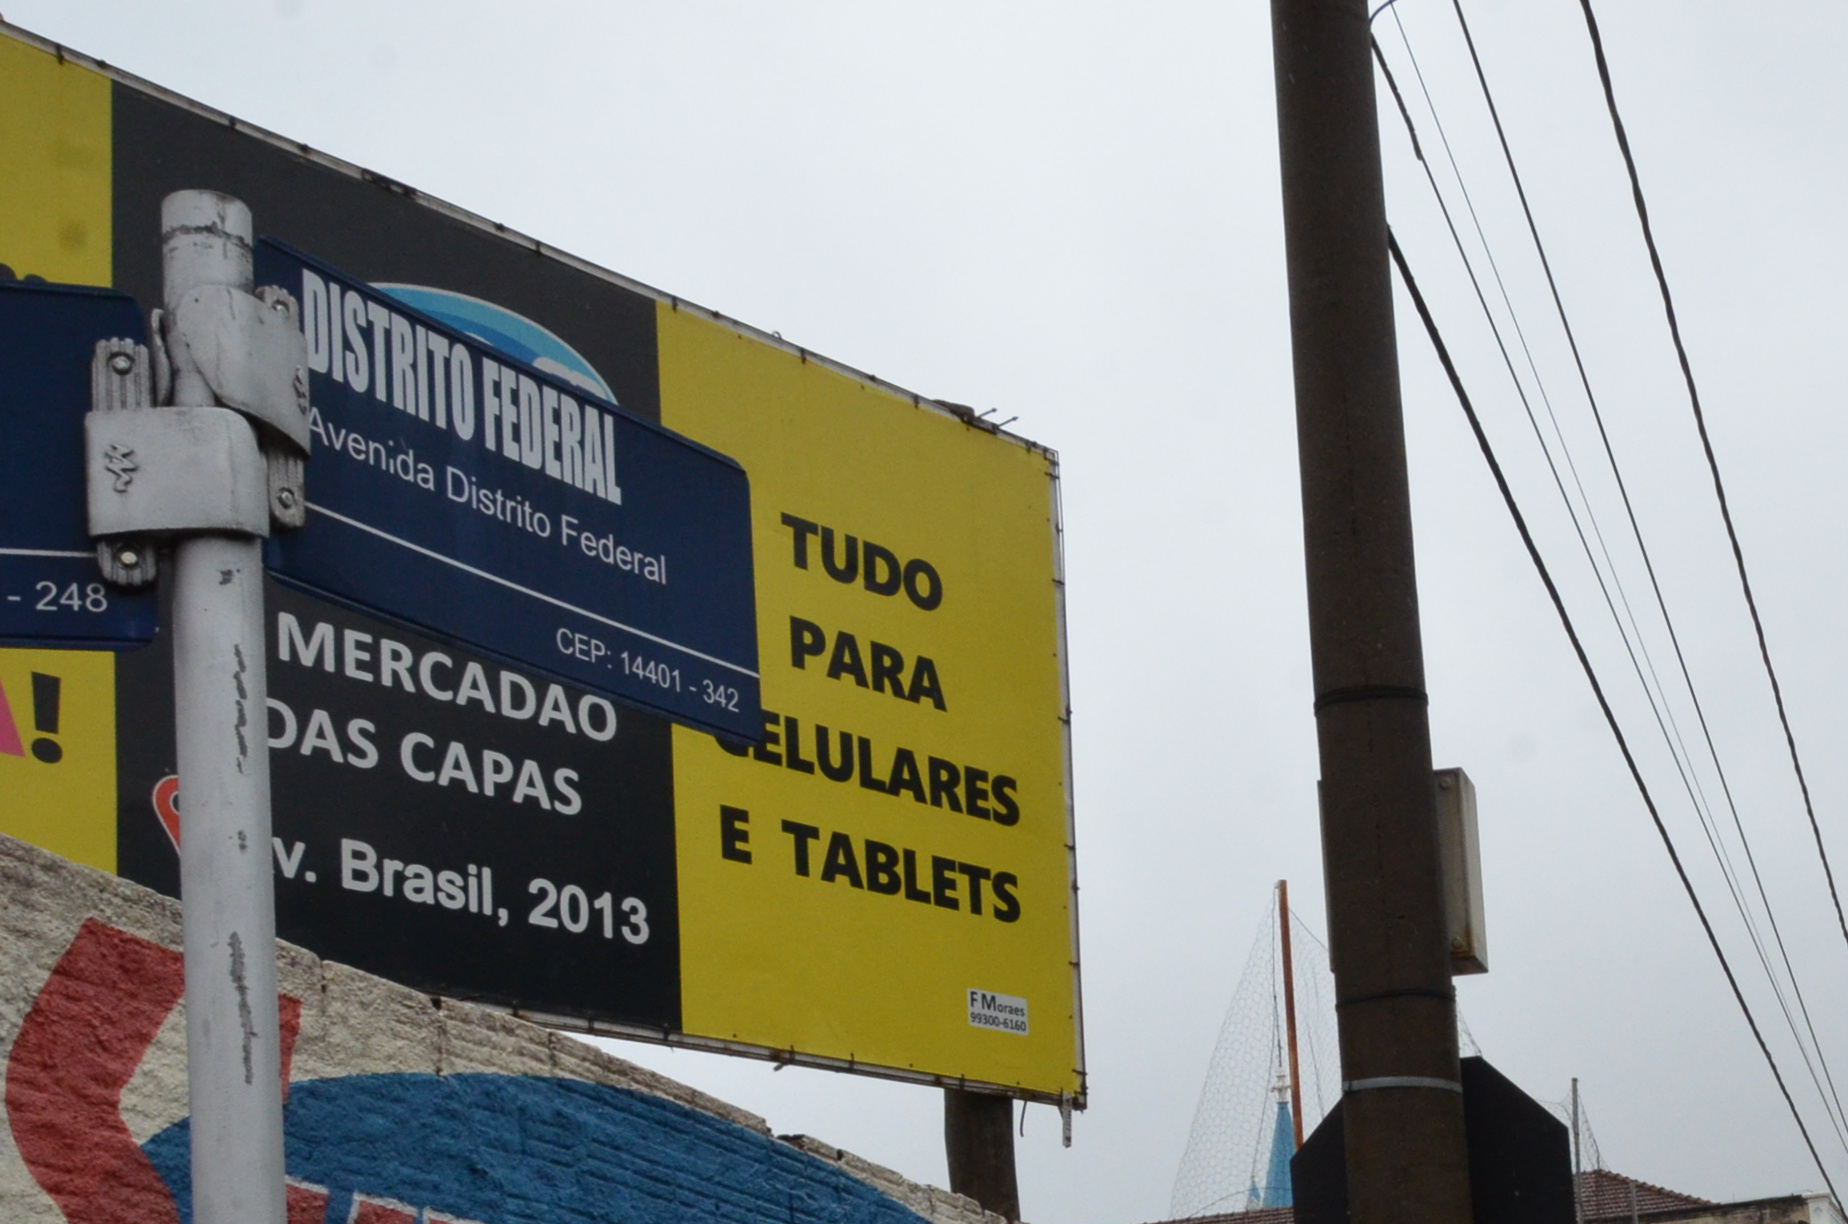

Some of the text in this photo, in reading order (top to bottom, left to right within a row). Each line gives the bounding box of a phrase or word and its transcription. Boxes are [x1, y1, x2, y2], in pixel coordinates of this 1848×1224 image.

[303, 269, 622, 505] DISTRITO FEDERAL
[307, 407, 667, 584] Avenida Distrito Federal
[36, 582, 108, 613] 248
[781, 512, 943, 611] TUDO
[278, 611, 617, 741] MERCADAO
[556, 628, 612, 669] CEP:
[620, 650, 682, 694] 14401
[702, 678, 740, 713] 342
[790, 616, 947, 712] PARA
[266, 697, 582, 815] DAS CAPAS
[272, 837, 650, 944] v. Brasil, 2013
[720, 804, 1021, 923] E TABLETS
[969, 991, 1026, 1017] F Moraes
[969, 1011, 1028, 1034] 99300-6160
